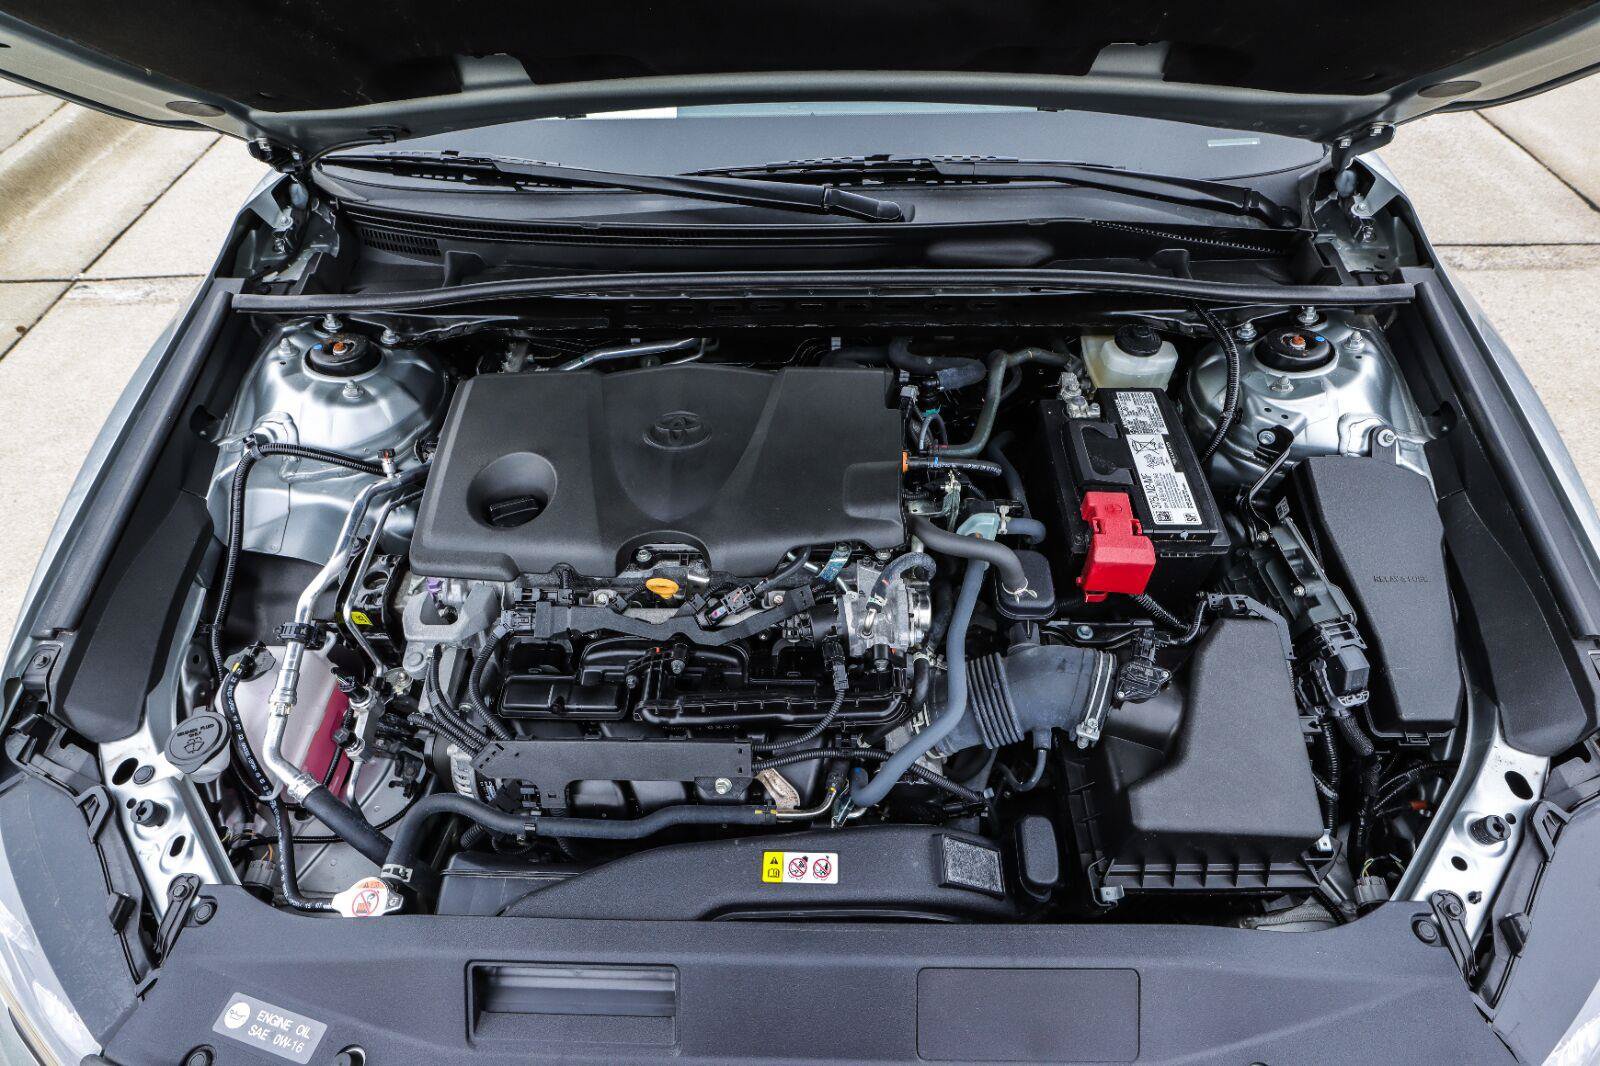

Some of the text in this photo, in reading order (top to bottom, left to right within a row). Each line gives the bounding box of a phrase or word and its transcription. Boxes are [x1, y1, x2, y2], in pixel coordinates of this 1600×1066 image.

[248, 1024, 304, 1054] SAE 0W-16
[256, 1010, 312, 1040] ENGINE OIL
